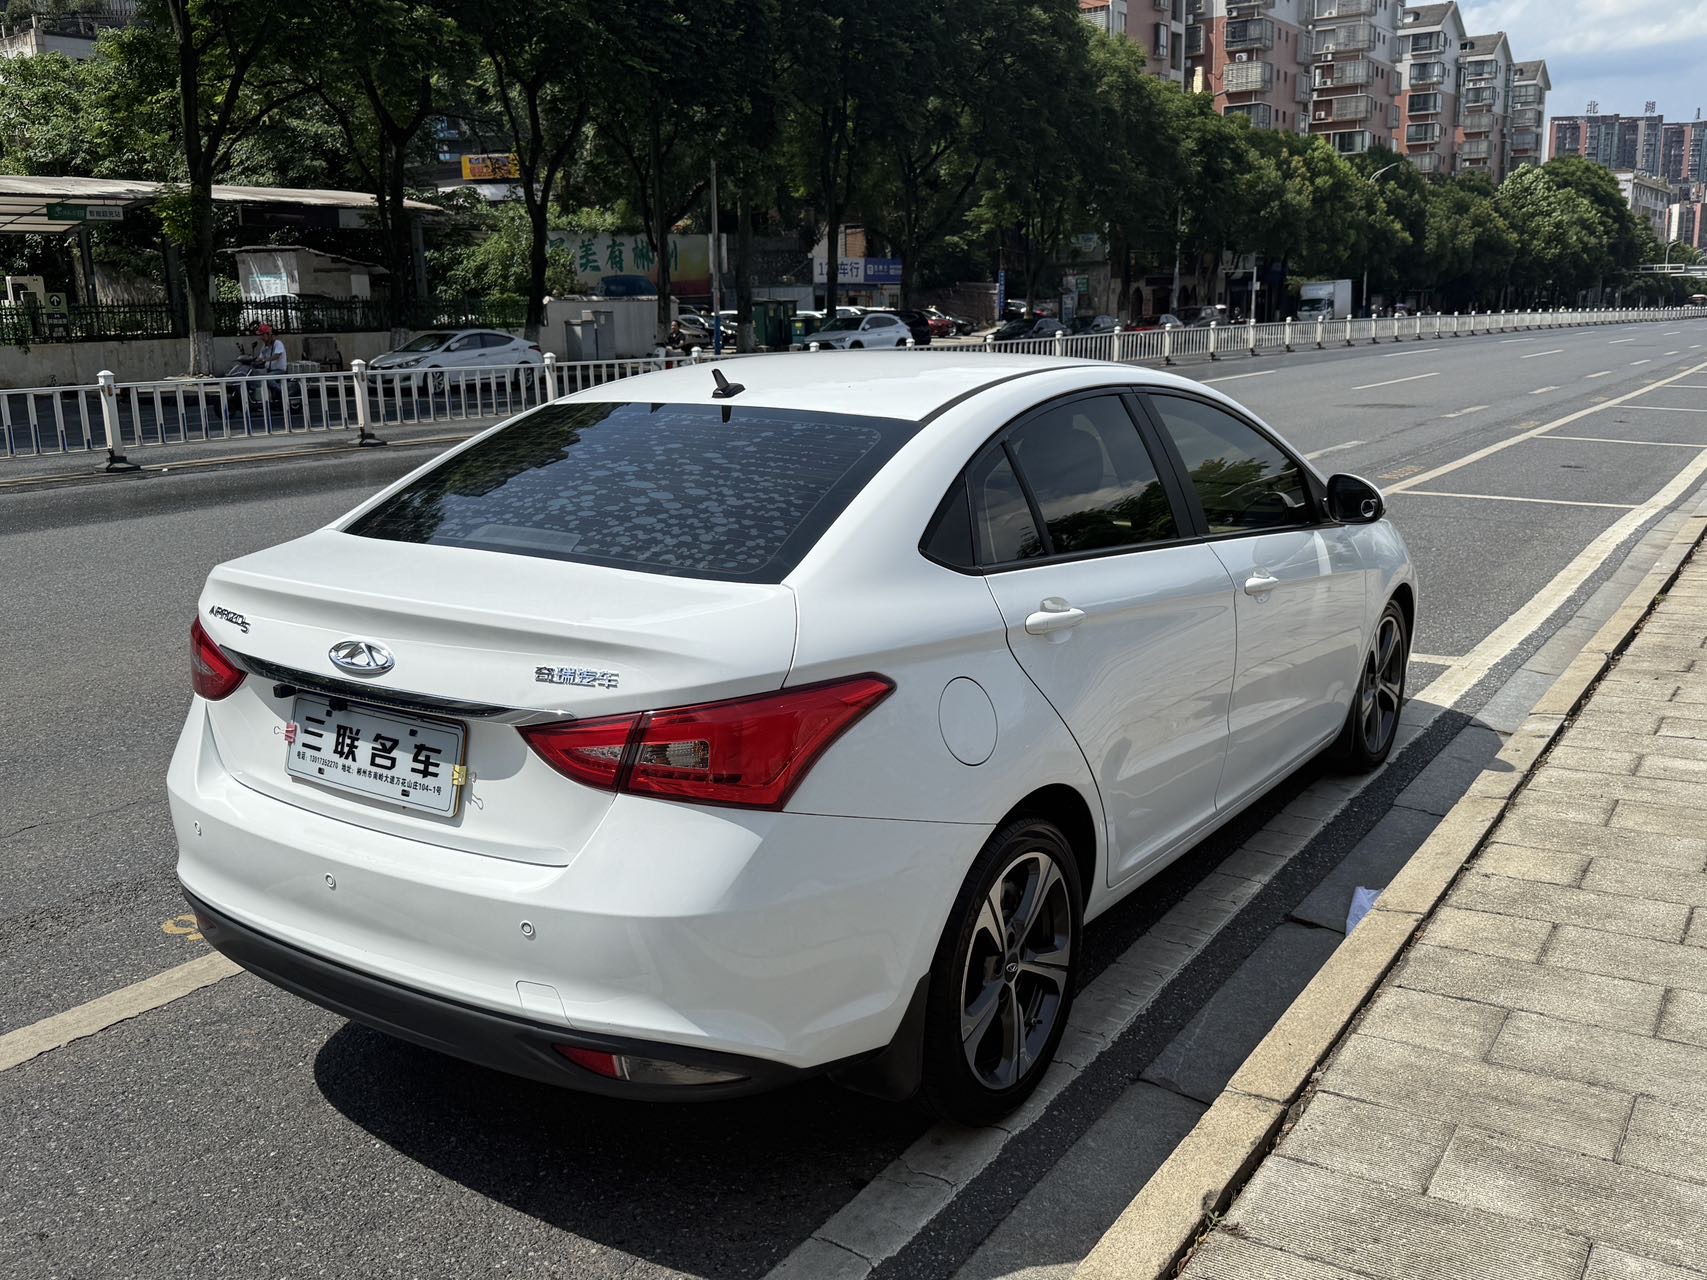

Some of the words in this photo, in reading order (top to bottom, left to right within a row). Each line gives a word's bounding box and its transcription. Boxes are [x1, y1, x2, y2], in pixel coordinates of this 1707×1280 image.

[535, 666, 620, 689] 奇瑞汽车
[302, 716, 443, 778] 三联名车
